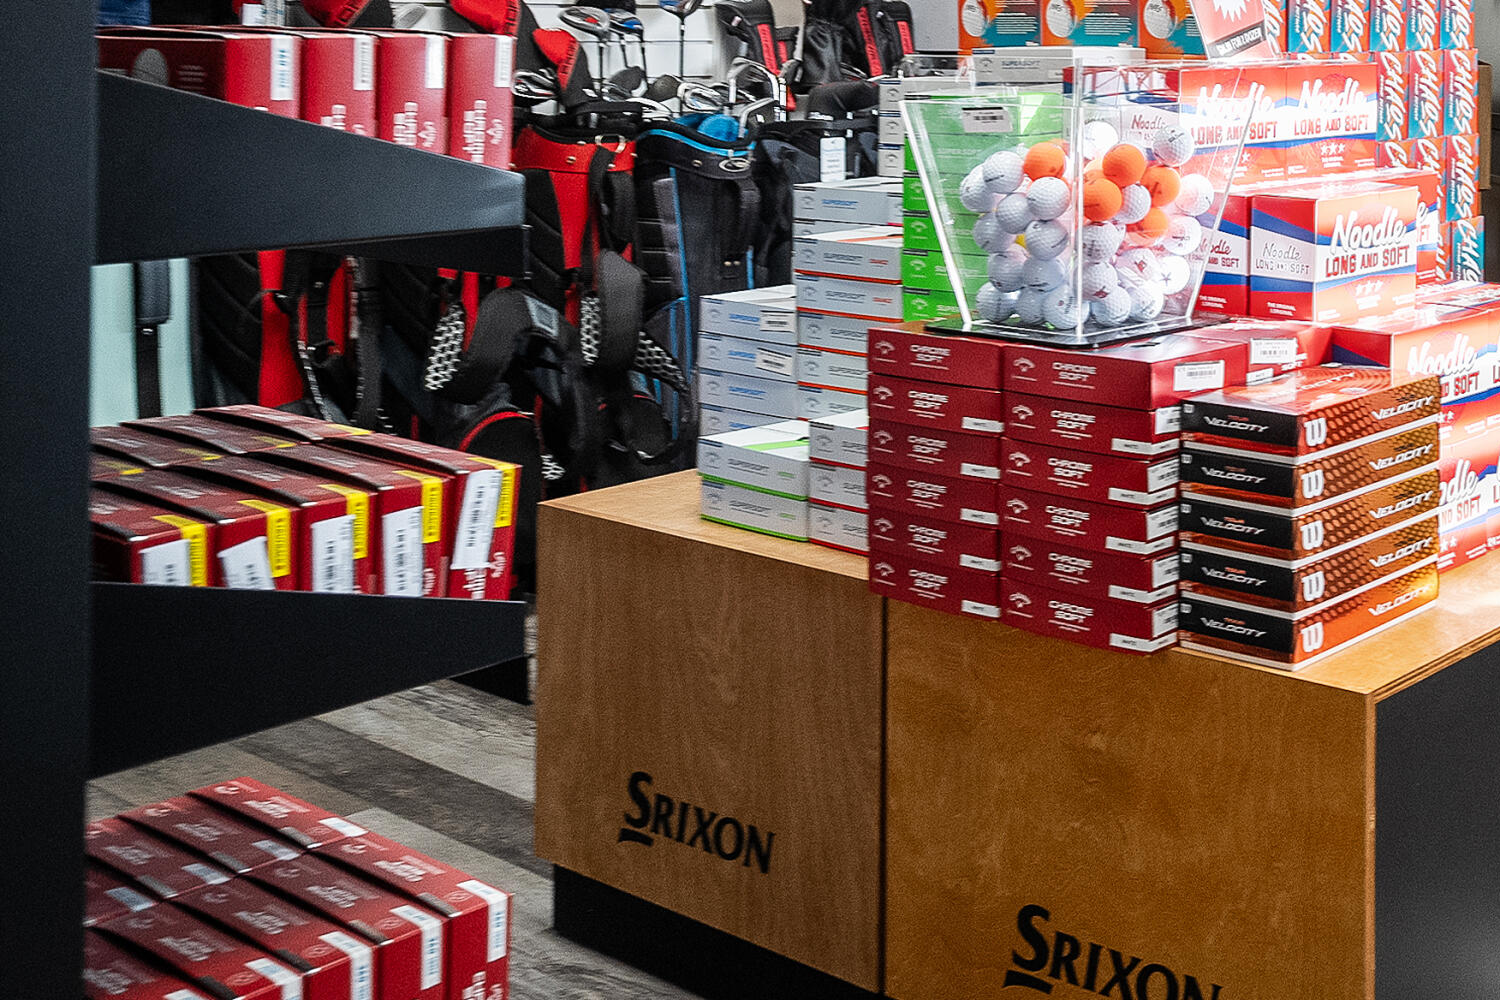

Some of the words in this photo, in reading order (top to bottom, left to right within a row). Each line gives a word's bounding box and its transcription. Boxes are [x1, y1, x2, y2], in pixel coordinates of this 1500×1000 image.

[1200, 82, 1273, 115] Noodle
[1300, 77, 1368, 111] Noodle
[1379, 51, 1407, 141] CHAOS
[1414, 50, 1442, 138] CHAOS
[1449, 50, 1476, 135] CHAOS
[1190, 126, 1223, 146] LONG
[1249, 121, 1278, 140] SOFT
[1294, 118, 1322, 136] LONG
[1325, 118, 1341, 132] AND
[1344, 114, 1369, 132] SOFT
[1453, 135, 1476, 219] CHAOS
[1330, 205, 1407, 255] Noodle
[1263, 243, 1302, 261] Noodle
[1457, 219, 1480, 283] CHAO
[1255, 259, 1273, 271] LONG
[1290, 264, 1310, 276] SOFT
[1325, 254, 1357, 277] LONG
[1360, 253, 1378, 270] AND
[1382, 246, 1410, 266] SOFT
[910, 344, 951, 357] CHROME
[1407, 333, 1477, 376] Noodle
[1052, 362, 1097, 376] CHROME
[1058, 371, 1089, 382] SOFT
[1454, 371, 1480, 397] SOFT
[907, 390, 949, 403] CHROME
[1050, 410, 1096, 423] CHROME
[1371, 394, 1434, 421] VELOCITY
[1056, 419, 1088, 431] SOFT
[1203, 416, 1269, 433] VELOCITY
[907, 435, 948, 448] CHROME
[1048, 457, 1093, 472] CHROME
[1369, 443, 1433, 470] VELOCITY
[1053, 467, 1085, 479] SOFT
[1201, 466, 1267, 484] VELOCITY
[906, 480, 947, 494] CHROME
[1045, 505, 1090, 521] CHROME
[1369, 491, 1433, 519] VELOCITY
[1456, 496, 1481, 522] SOFT
[1051, 515, 1083, 528] SOFT
[1200, 516, 1266, 535] VELOCITY
[907, 524, 948, 540] CHROME
[1048, 552, 1093, 568] CHROME
[1369, 536, 1433, 568] VELOCITY
[908, 569, 949, 584] CHROME
[1053, 562, 1084, 575] SOFT
[1201, 567, 1267, 586] VELOCITY
[1048, 600, 1094, 617] CHROME
[1368, 583, 1433, 616] VELOCITY
[1054, 610, 1085, 624] SOFT
[1200, 617, 1267, 637] VELOCITY
[619, 771, 777, 875] SRIXON
